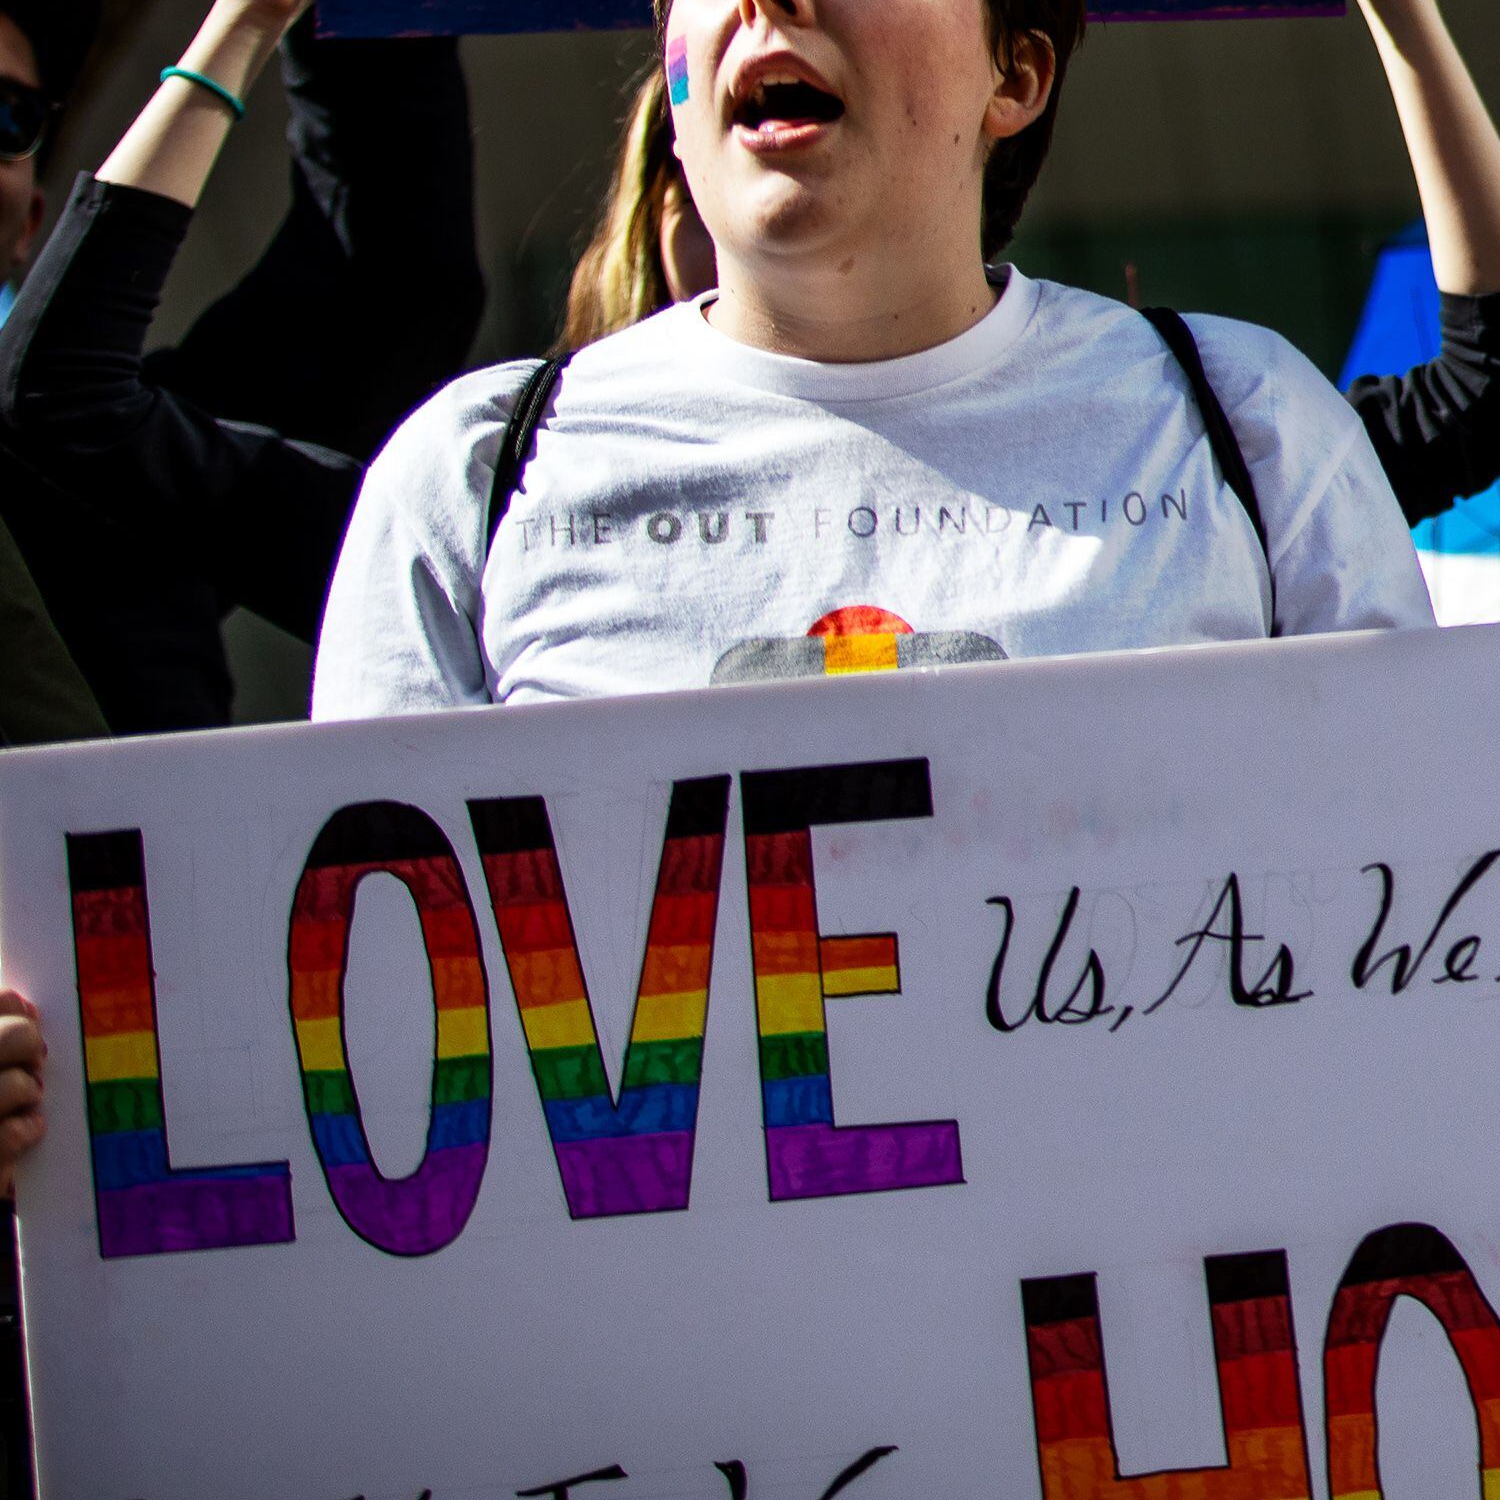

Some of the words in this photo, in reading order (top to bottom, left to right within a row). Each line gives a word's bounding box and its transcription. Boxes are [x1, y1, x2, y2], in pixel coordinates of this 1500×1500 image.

[515, 511, 612, 551] THE
[647, 511, 776, 545] OUT
[814, 488, 1190, 539] FOUNDATION
[65, 757, 968, 1259] LOVE
[986, 885, 1137, 1032] Us,
[1143, 871, 1313, 1007] As
